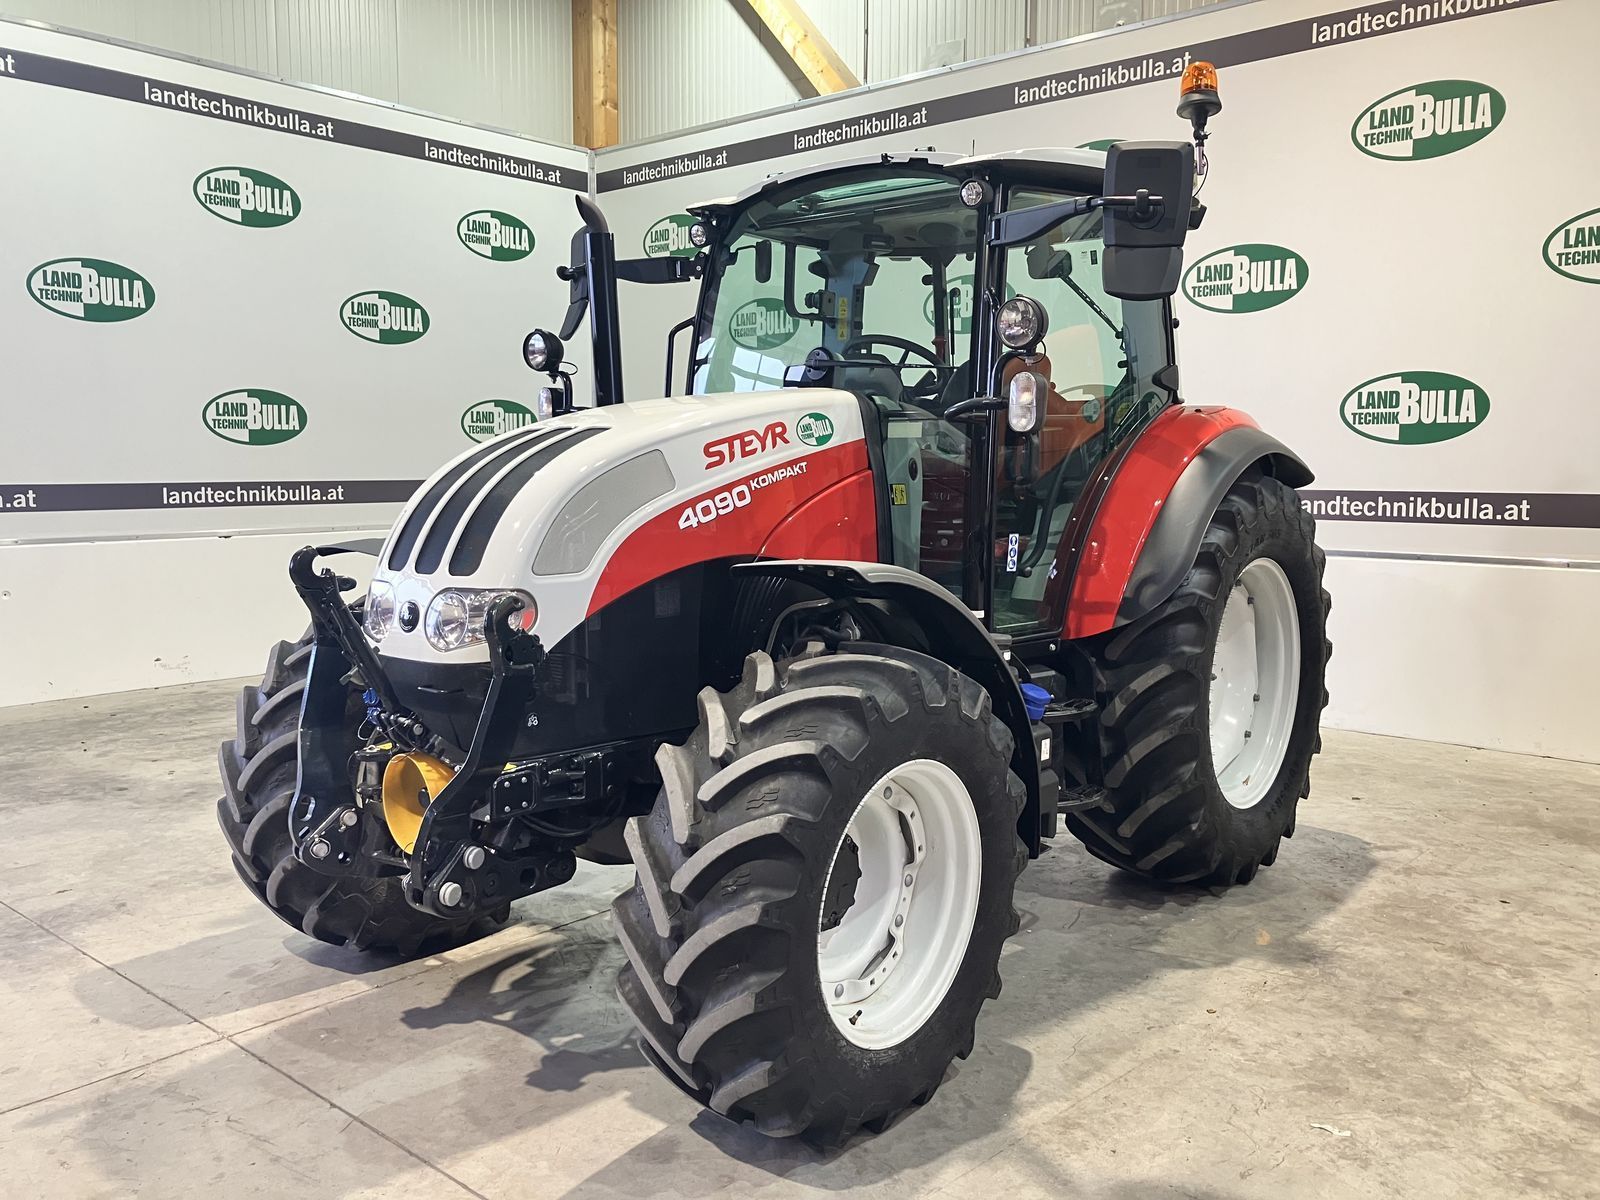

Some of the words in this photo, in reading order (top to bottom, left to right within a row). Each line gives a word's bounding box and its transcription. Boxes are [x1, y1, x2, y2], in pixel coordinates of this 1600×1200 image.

[1311, 0, 1520, 44] landtechnikbu
[1014, 52, 1191, 104] landtechnikbulla.at
[144, 82, 334, 138] landtechnikbulla.at
[1369, 104, 1414, 130] LAND
[1413, 93, 1492, 140] BULLA
[794, 107, 927, 150] landtechnikbulla.at
[1363, 126, 1414, 147] TECHNIK
[425, 142, 561, 183] landtechnikbulla.at
[623, 150, 728, 185] landtechnikbulla.at
[206, 176, 240, 196] LAND
[240, 175, 294, 217] BULLA
[203, 193, 241, 209] TECHNIK
[467, 219, 491, 235] LAND
[491, 218, 530, 252] BULLA
[650, 229, 670, 243] LAND
[669, 222, 695, 252] BUL
[464, 233, 491, 246] TECHNIK
[42, 269, 82, 289] LAND
[1196, 263, 1233, 283] LAND
[1233, 255, 1298, 295] BULLA
[38, 287, 83, 303] TECHNIK
[82, 267, 146, 309] BULLA
[1191, 283, 1233, 298] TECHNIK
[351, 301, 379, 317] LAND
[378, 298, 423, 333] BULLA
[736, 312, 757, 327] LAND
[348, 316, 379, 329] TECHNIK
[756, 306, 794, 336] BULLA
[215, 402, 248, 417] LAND
[1357, 390, 1400, 410] LAND
[1399, 382, 1477, 425] BULLA
[212, 418, 248, 430] TECHNIK
[247, 397, 300, 430] BULLA
[470, 411, 495, 424] LAND
[1351, 411, 1400, 425] TECHNIK
[468, 425, 495, 434] TECHNIK
[799, 422, 813, 433] LAND
[810, 417, 832, 438] BULLA
[703, 421, 790, 470] STEYR
[162, 485, 344, 505] landtechnikbulla.at
[678, 484, 752, 530] 4090
[750, 461, 807, 491] KOMPAKT
[1300, 496, 1531, 521] andtechnikbulla.at
